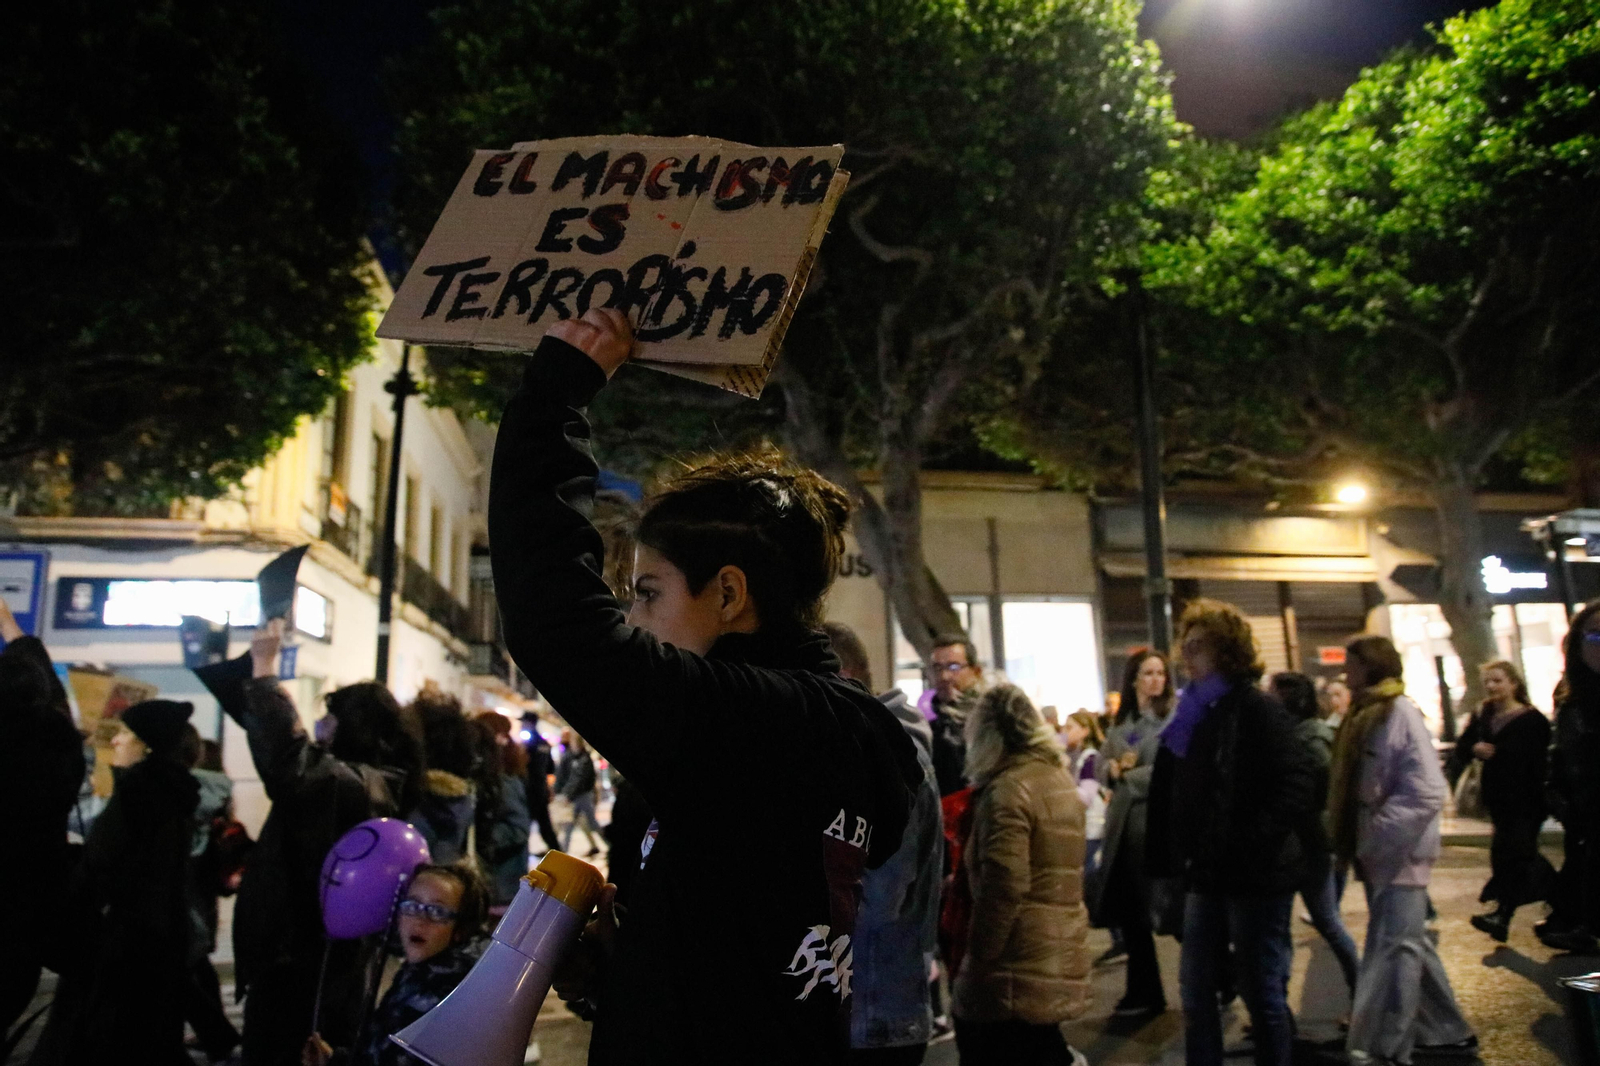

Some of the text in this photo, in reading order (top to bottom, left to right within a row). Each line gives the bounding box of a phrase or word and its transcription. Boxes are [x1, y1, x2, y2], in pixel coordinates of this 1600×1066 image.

[473, 151, 833, 211] EL MACHISMO
[536, 203, 631, 254] ES
[422, 241, 788, 342] TERRORISMO
